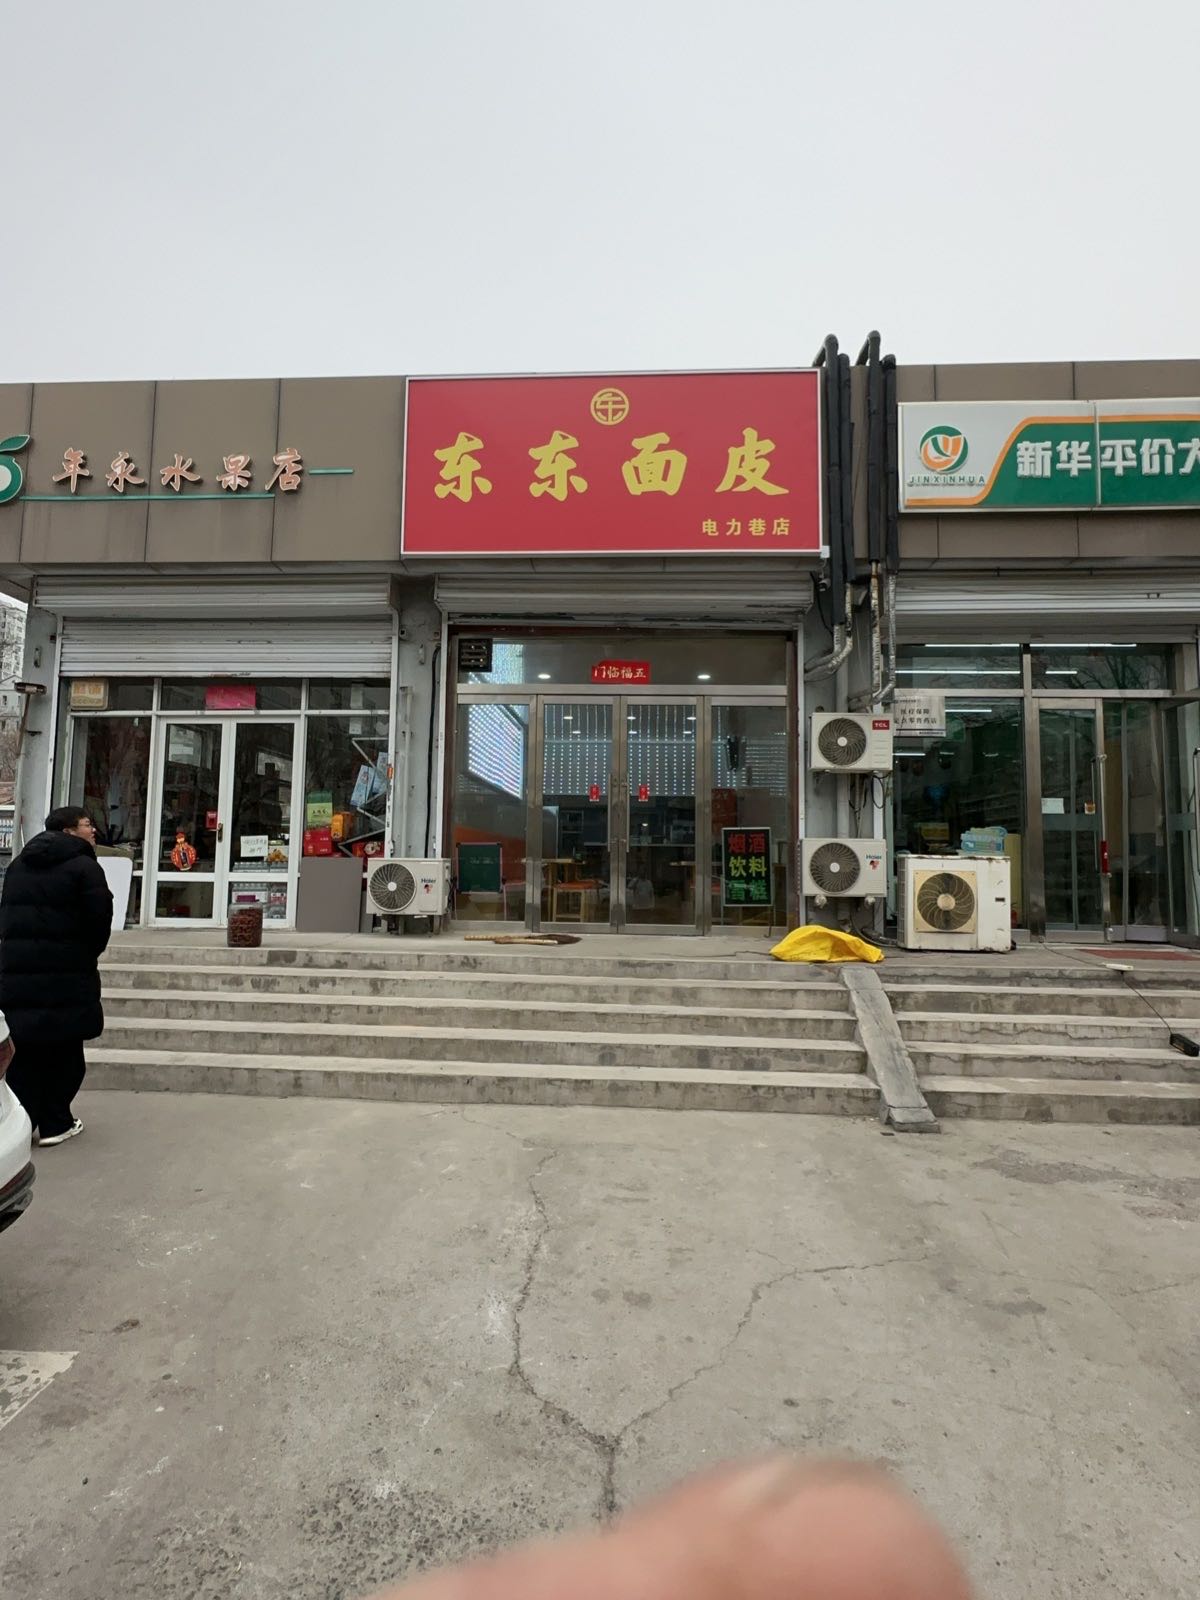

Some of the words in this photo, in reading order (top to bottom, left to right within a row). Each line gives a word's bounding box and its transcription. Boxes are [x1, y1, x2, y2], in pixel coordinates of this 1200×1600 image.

[434, 427, 789, 502] 东东面皮
[909, 475, 985, 484] JINXINHUA
[701, 517, 790, 536] 电力巷店
[728, 833, 766, 854] 烟酒
[728, 855, 768, 877] 饮料
[728, 879, 768, 901] 雪糕
